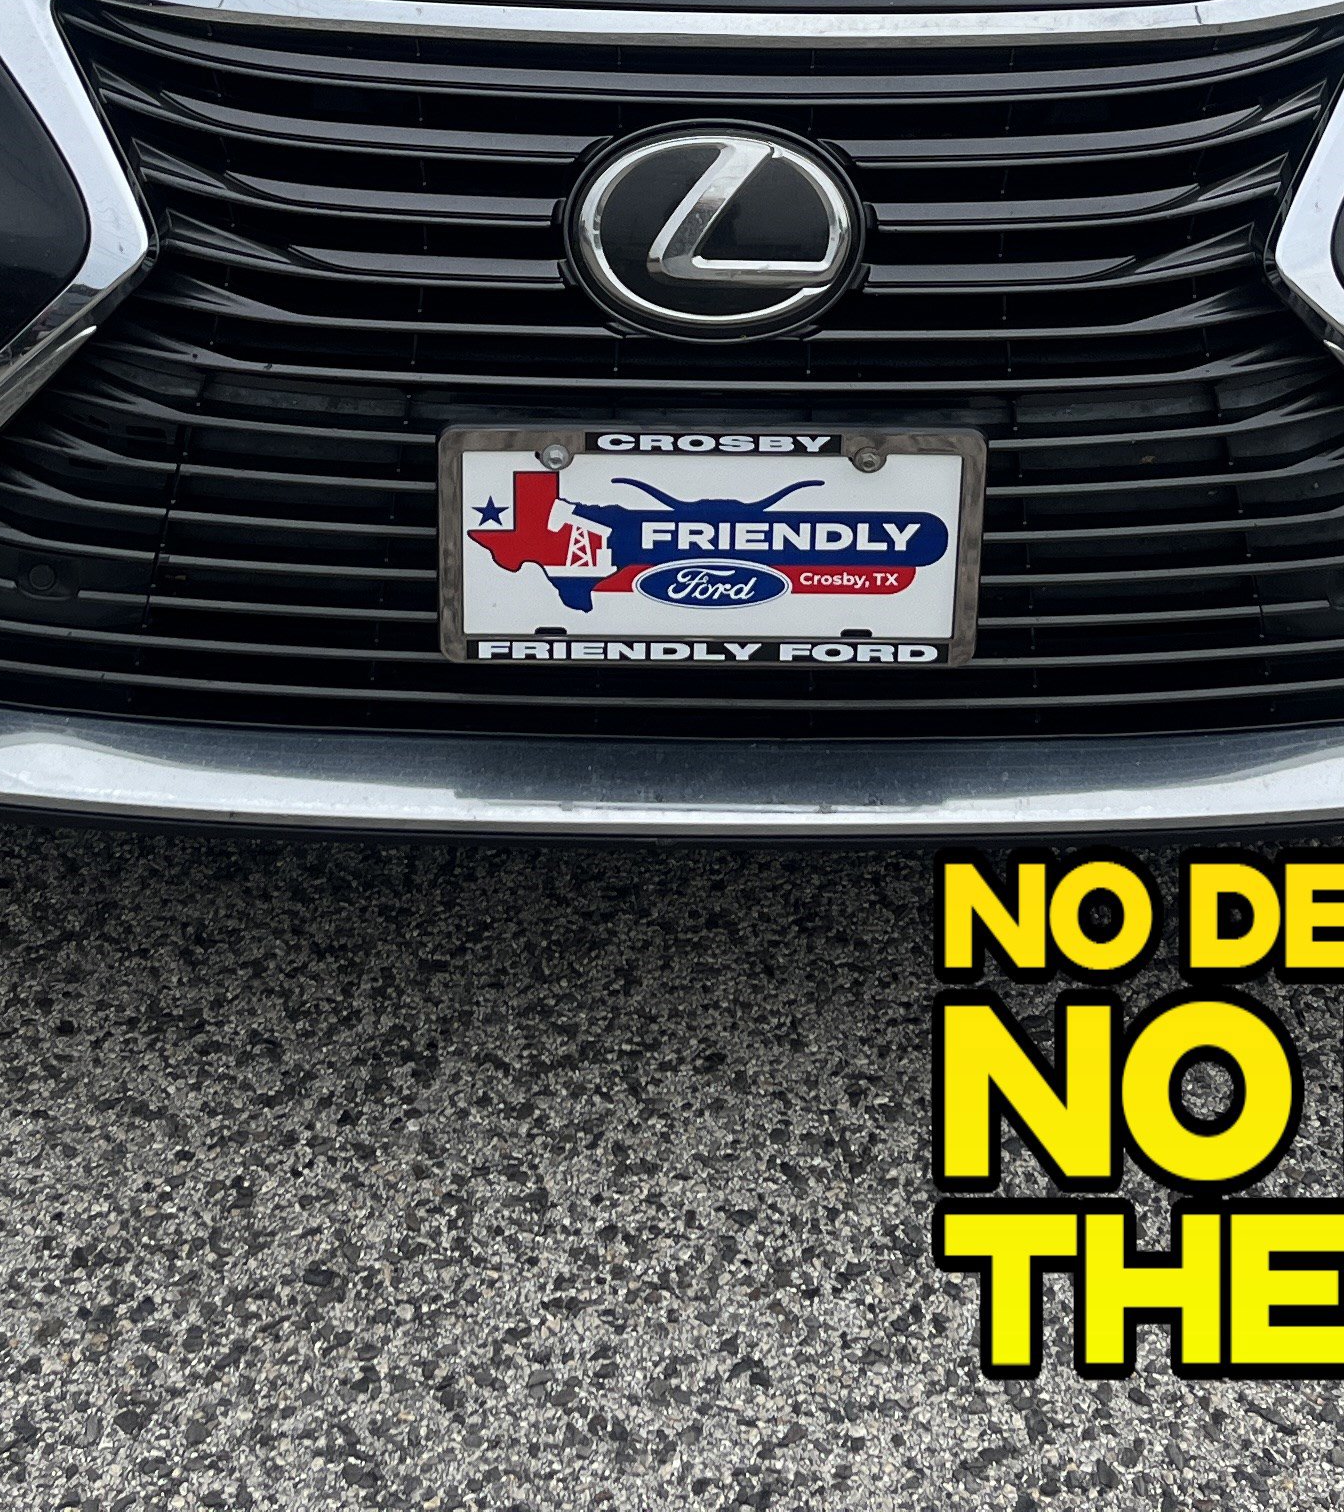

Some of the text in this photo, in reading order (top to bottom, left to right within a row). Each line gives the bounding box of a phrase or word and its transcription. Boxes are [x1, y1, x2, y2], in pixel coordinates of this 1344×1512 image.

[596, 433, 832, 454] CROSBY
[640, 521, 922, 552] FRIENDLY
[666, 568, 757, 603] Ford
[798, 571, 899, 590] Crosby, TX
[477, 640, 939, 663] FRIENDLY FORD
